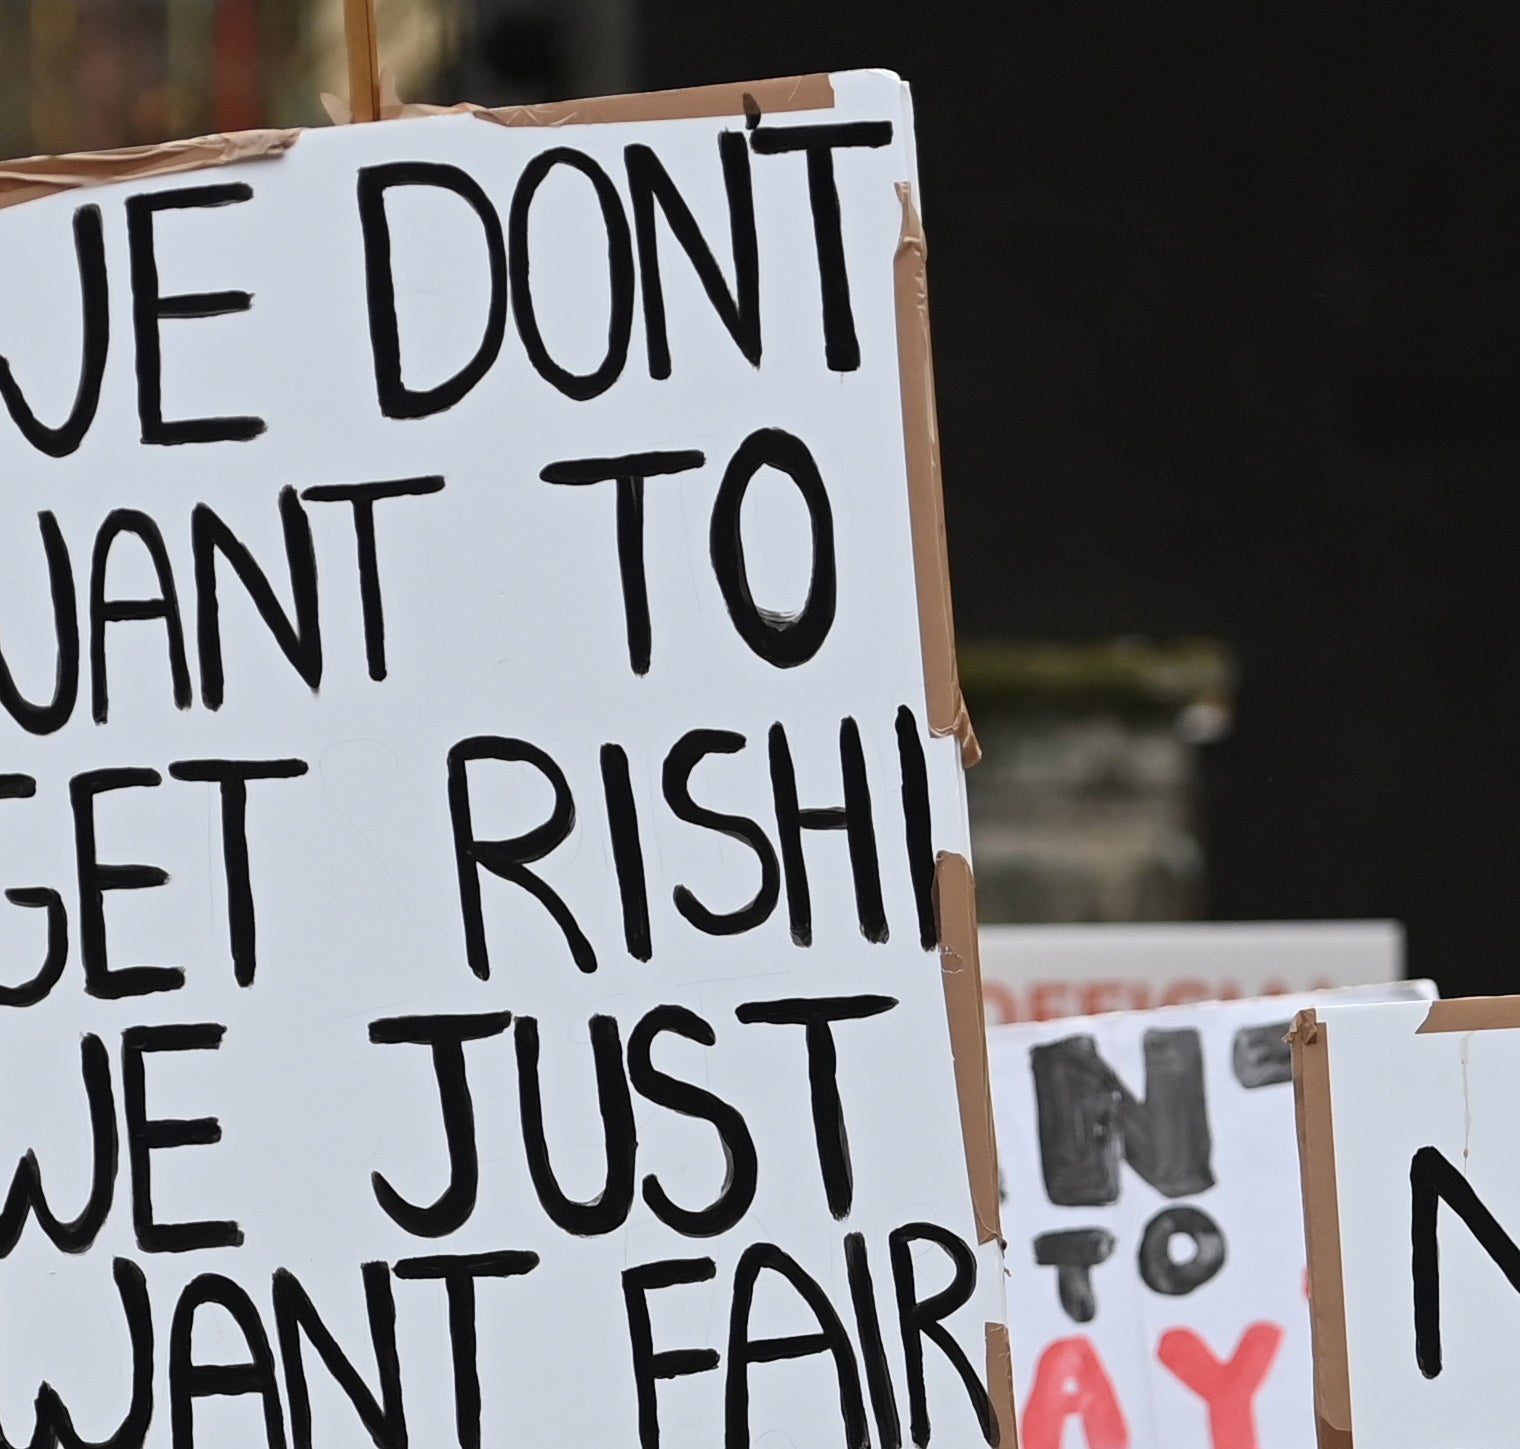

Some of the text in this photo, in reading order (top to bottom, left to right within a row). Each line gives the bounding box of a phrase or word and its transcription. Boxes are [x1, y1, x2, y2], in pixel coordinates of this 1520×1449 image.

[356, 93, 895, 420] DON'T
[540, 427, 838, 677] TO
[446, 704, 940, 981] RISHI
[367, 993, 900, 1240] JUST
[1033, 1204, 1228, 1323] TO
